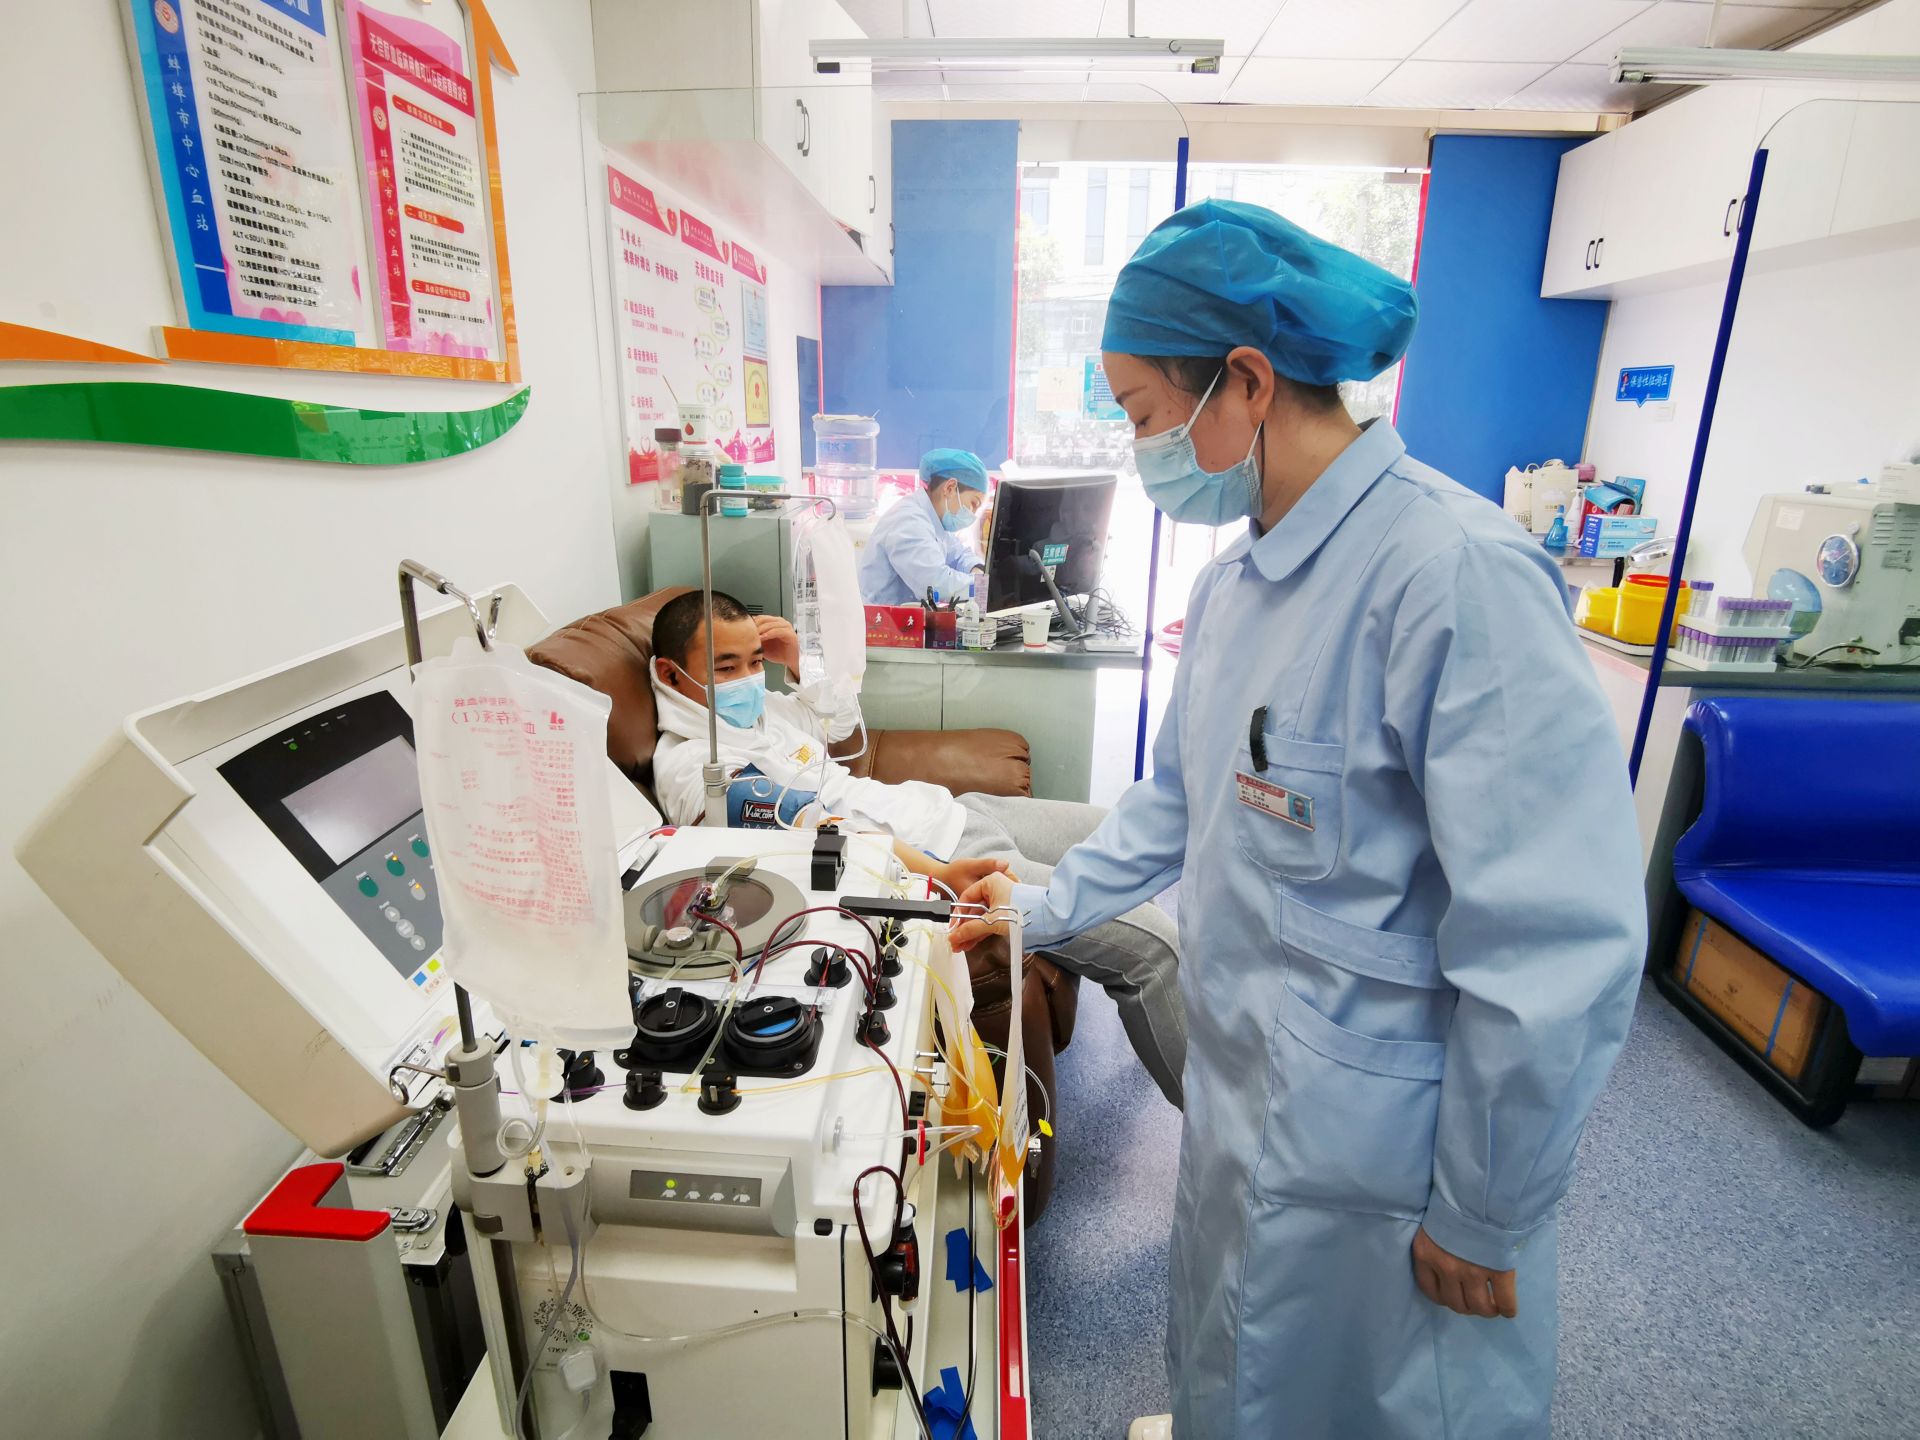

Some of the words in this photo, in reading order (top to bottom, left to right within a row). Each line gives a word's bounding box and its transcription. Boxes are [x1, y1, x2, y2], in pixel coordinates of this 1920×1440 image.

[167, 54, 210, 231] 蚌埠市中心血站
